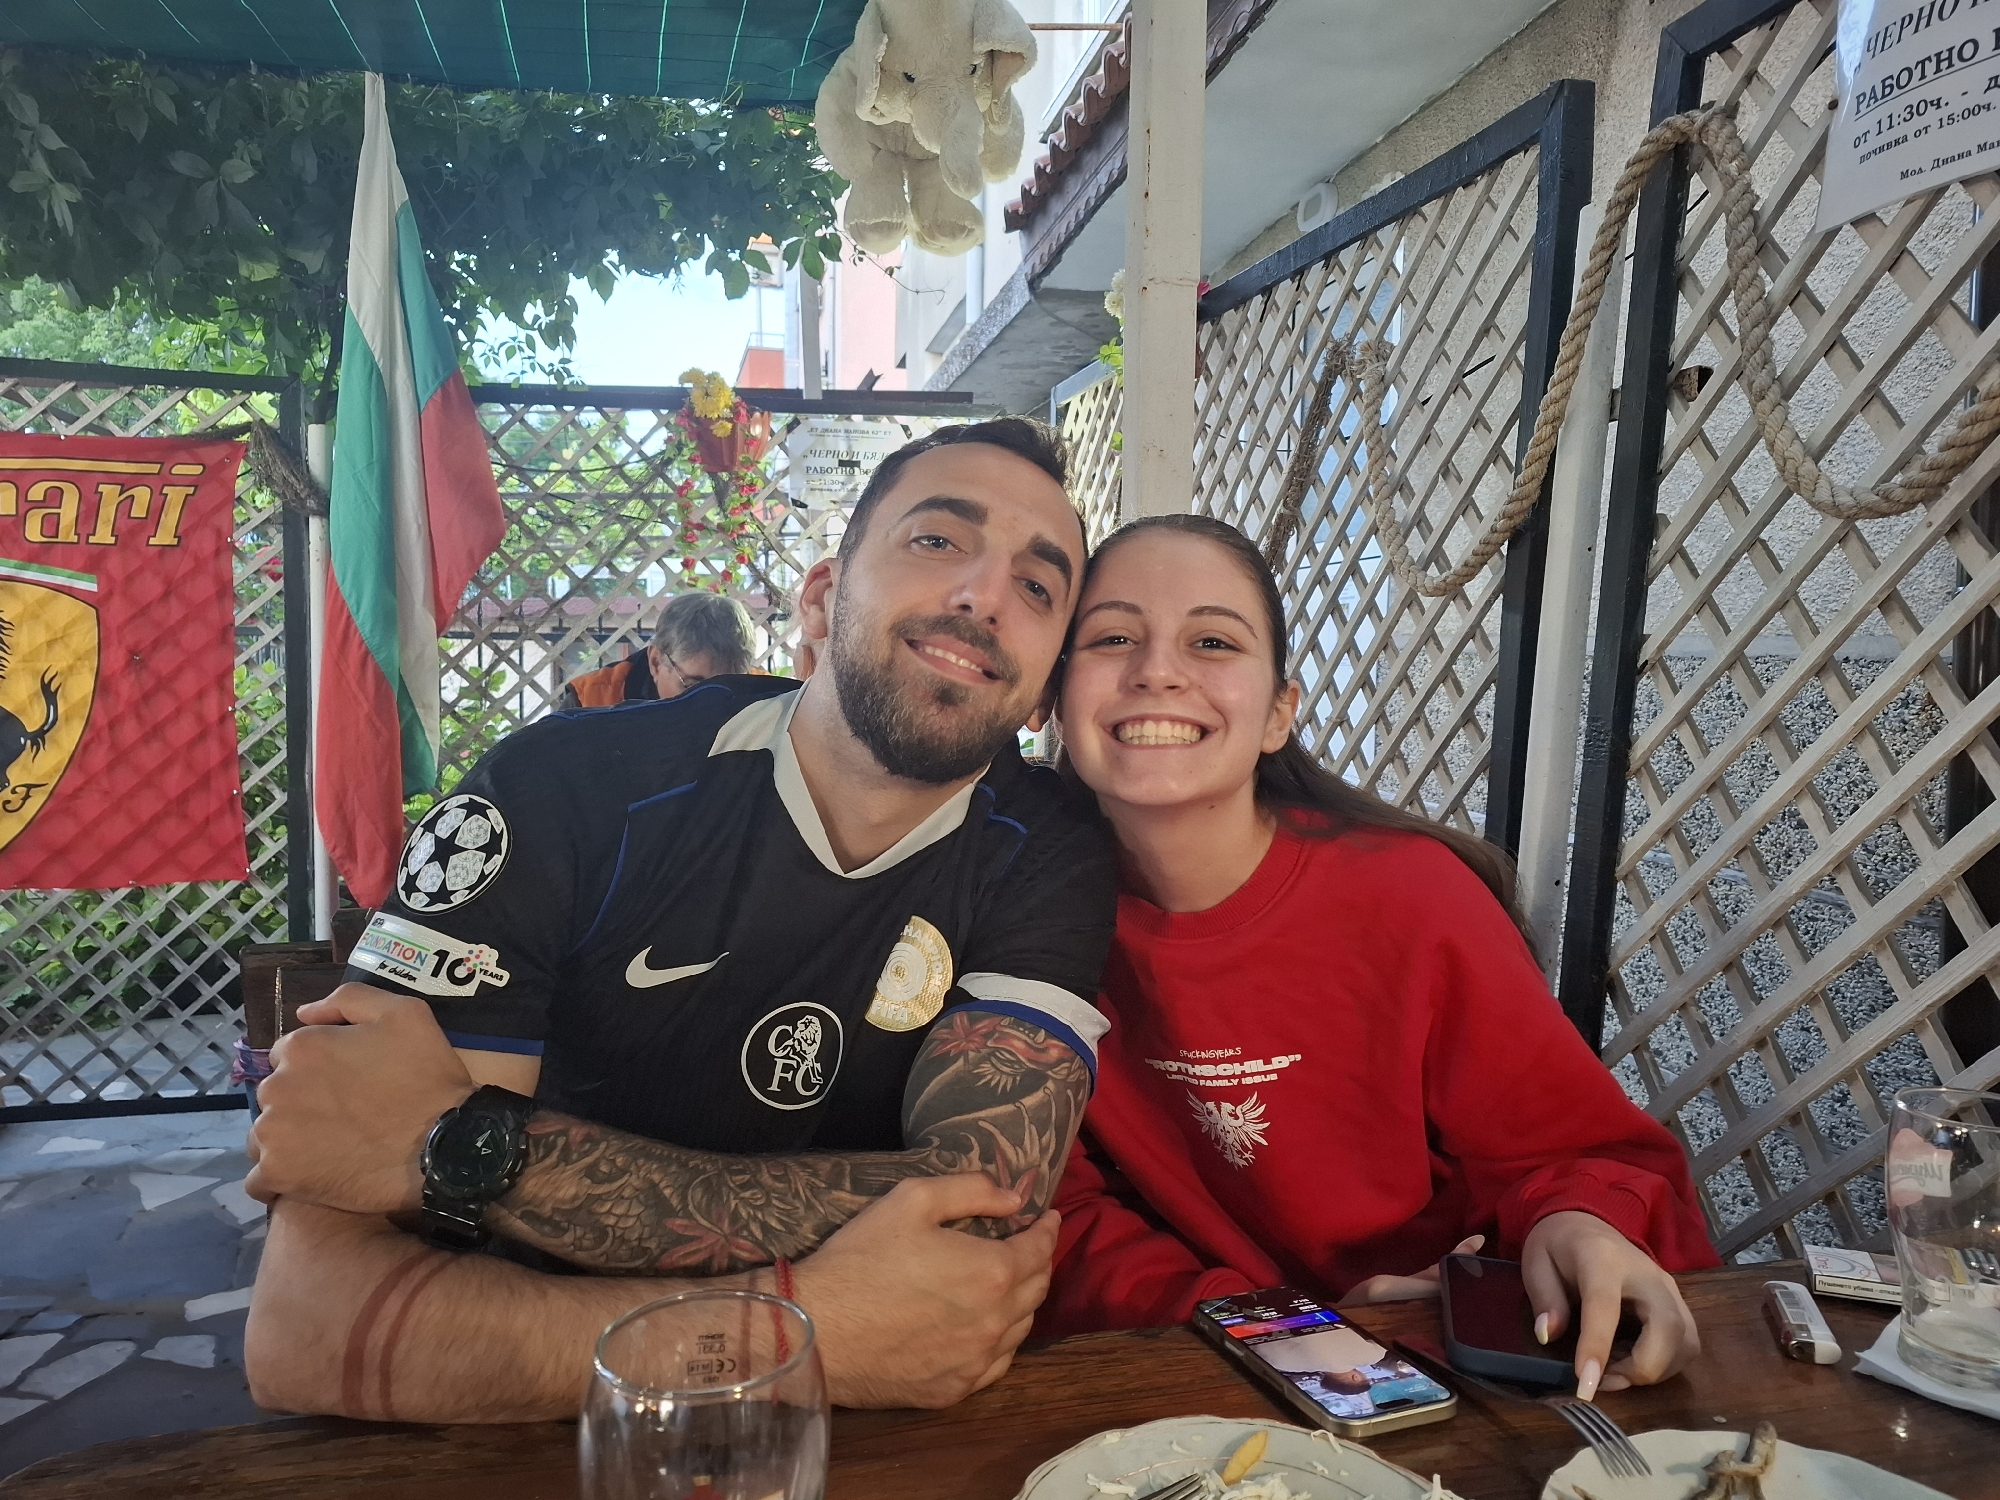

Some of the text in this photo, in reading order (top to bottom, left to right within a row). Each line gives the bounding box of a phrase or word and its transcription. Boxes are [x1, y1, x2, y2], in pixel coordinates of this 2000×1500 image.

[1854, 38, 1979, 116] РАБОТНО
[1853, 130, 1870, 149] от
[1876, 96, 1949, 136] 11:30ч.
[1859, 101, 1997, 165] почивка от 15:00ч.
[1930, 148, 1972, 171] Диана
[851, 451, 860, 460] И
[805, 466, 855, 475] РАБОТНО
[360, 932, 428, 966] FOUNDATION
[375, 960, 418, 983] for children
[430, 948, 504, 986] 10 YEARS
[871, 999, 908, 1022] FIFA
[1167, 1073, 1278, 1087] LIMITED FAMILY ISSUE
